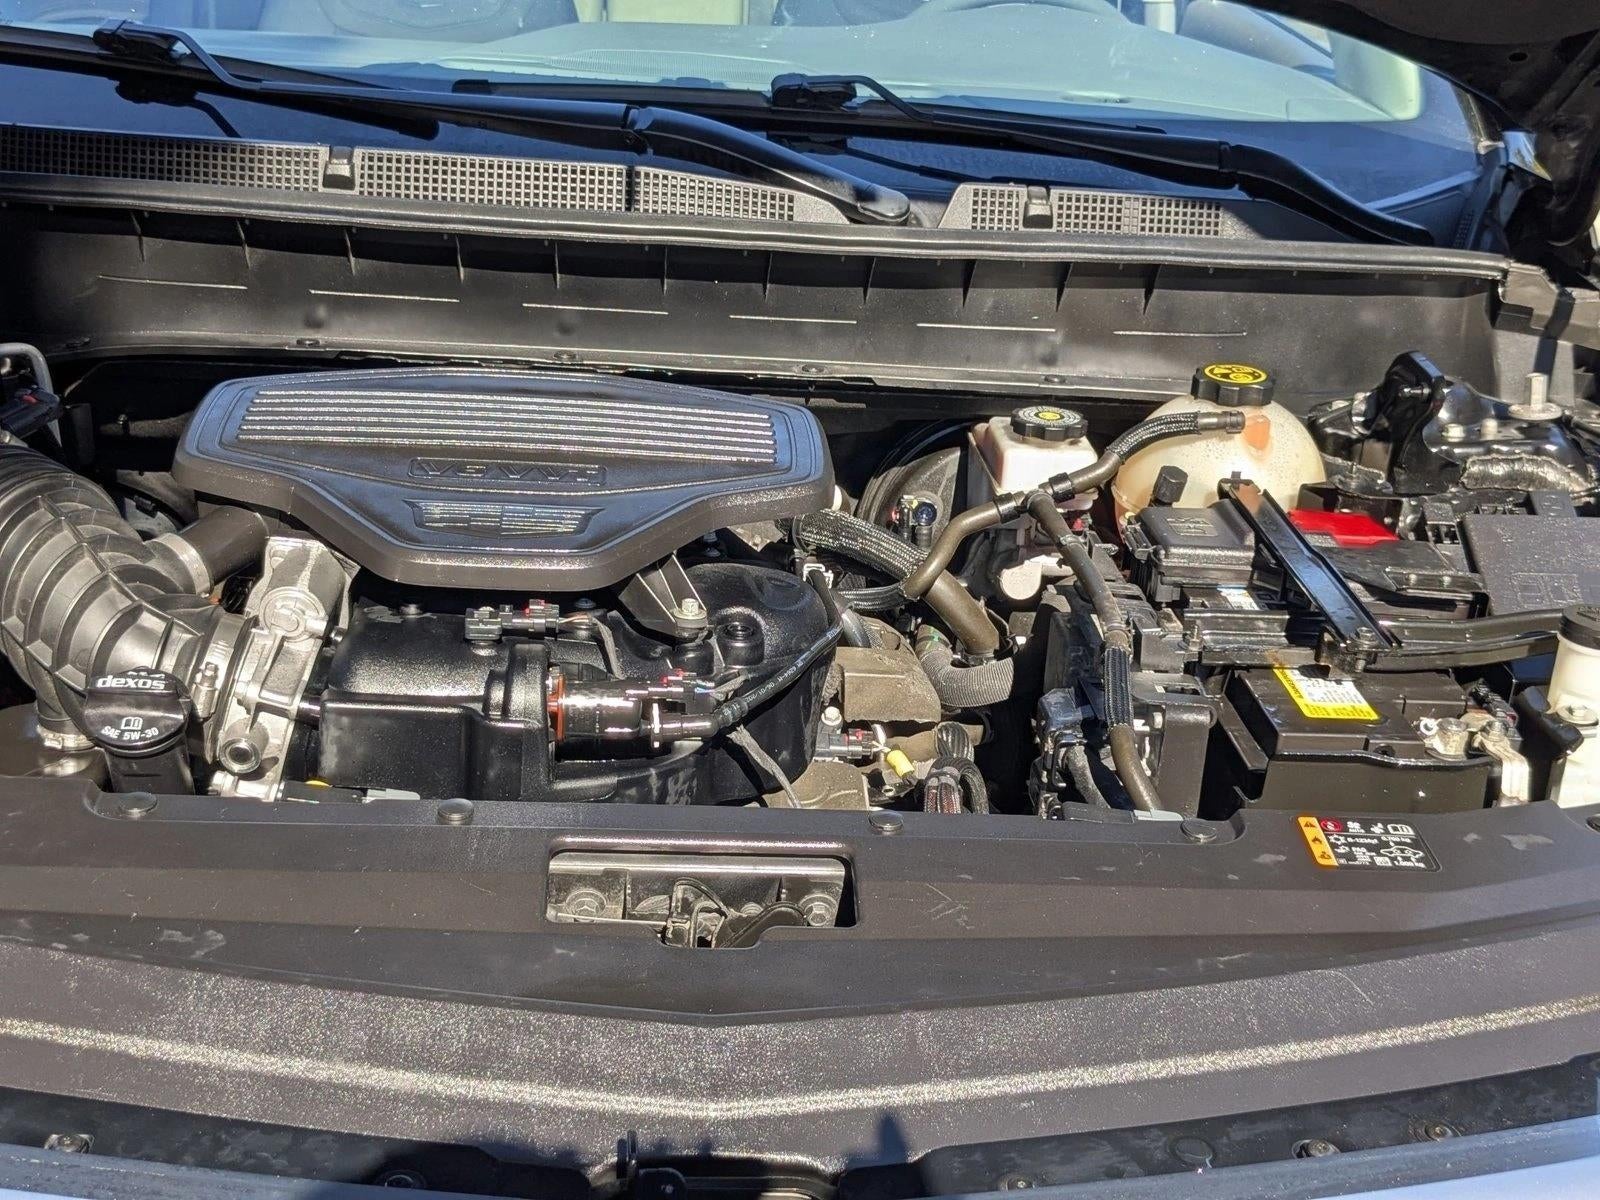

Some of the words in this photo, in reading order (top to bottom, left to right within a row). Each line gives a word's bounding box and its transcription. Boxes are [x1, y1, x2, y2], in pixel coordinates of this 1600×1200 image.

[96, 674, 165, 690] dexos
[101, 725, 121, 739] SAE
[123, 727, 159, 741] 5W-30
